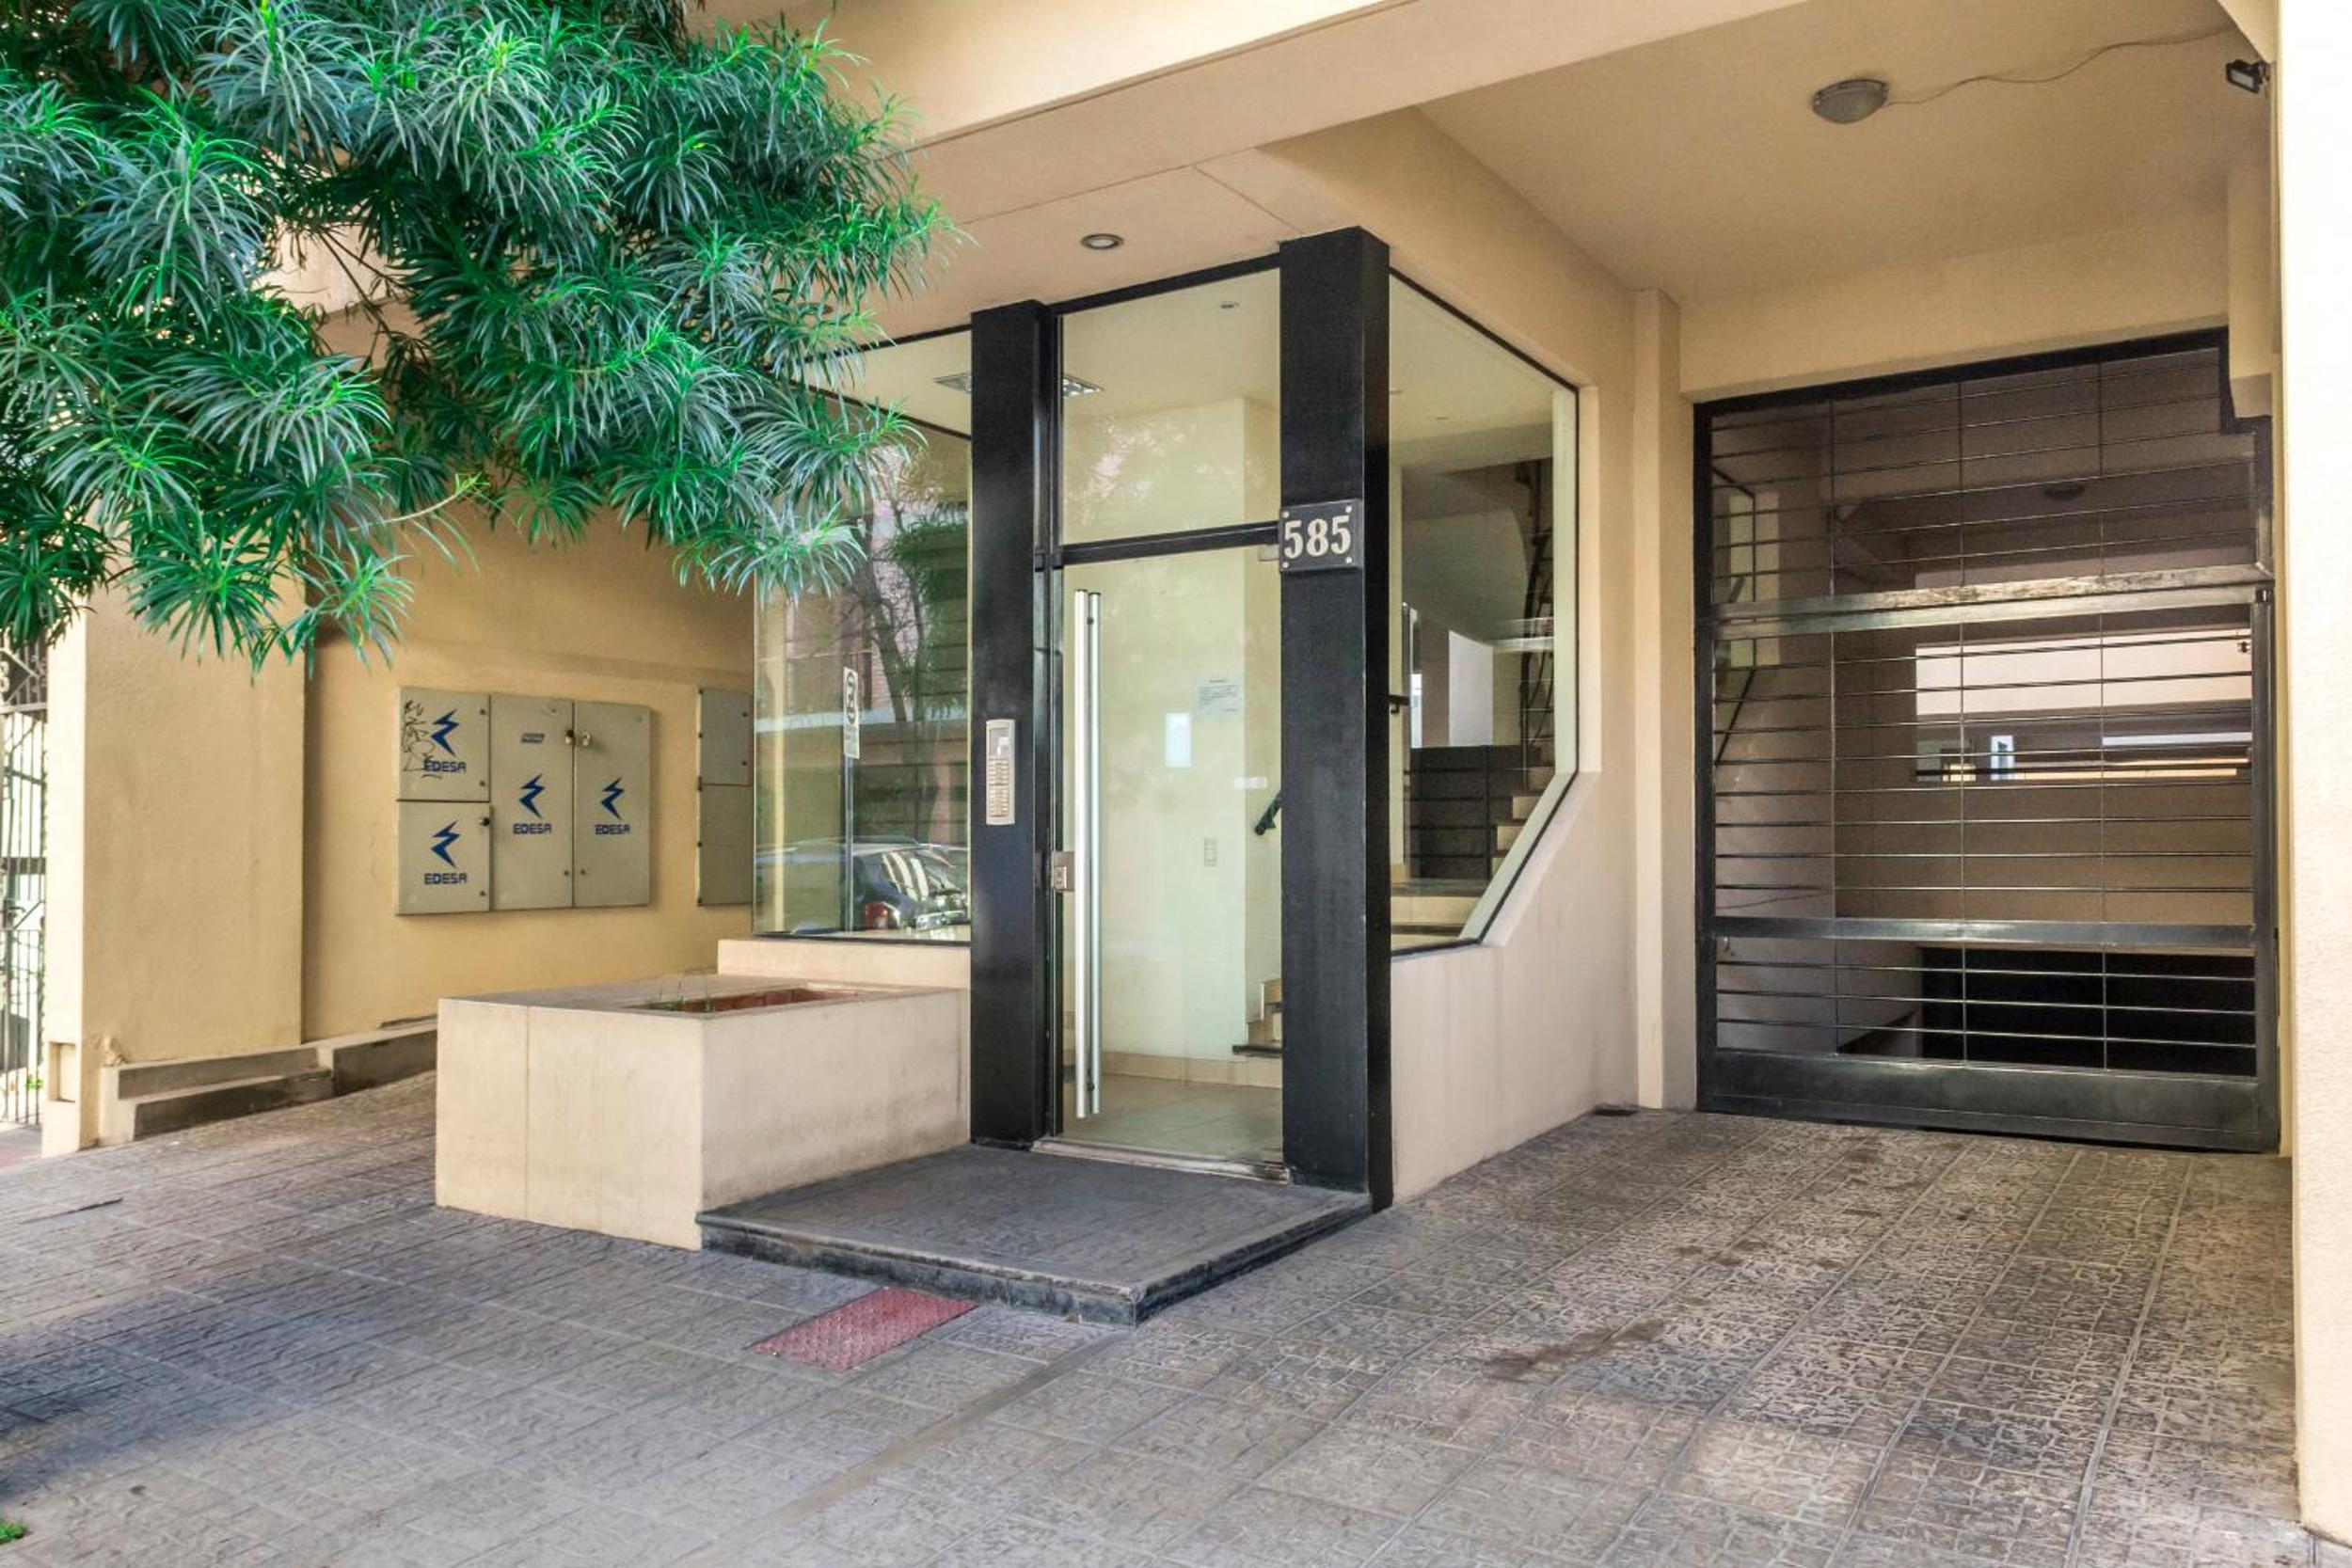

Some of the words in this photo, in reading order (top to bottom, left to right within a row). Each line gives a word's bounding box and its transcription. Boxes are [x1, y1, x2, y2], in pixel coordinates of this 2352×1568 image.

[1283, 515, 1352, 560] 585
[424, 760, 467, 773] EDESA
[513, 823, 552, 835] EDESA
[595, 824, 630, 835] EDESA
[424, 873, 468, 885] EDESA
